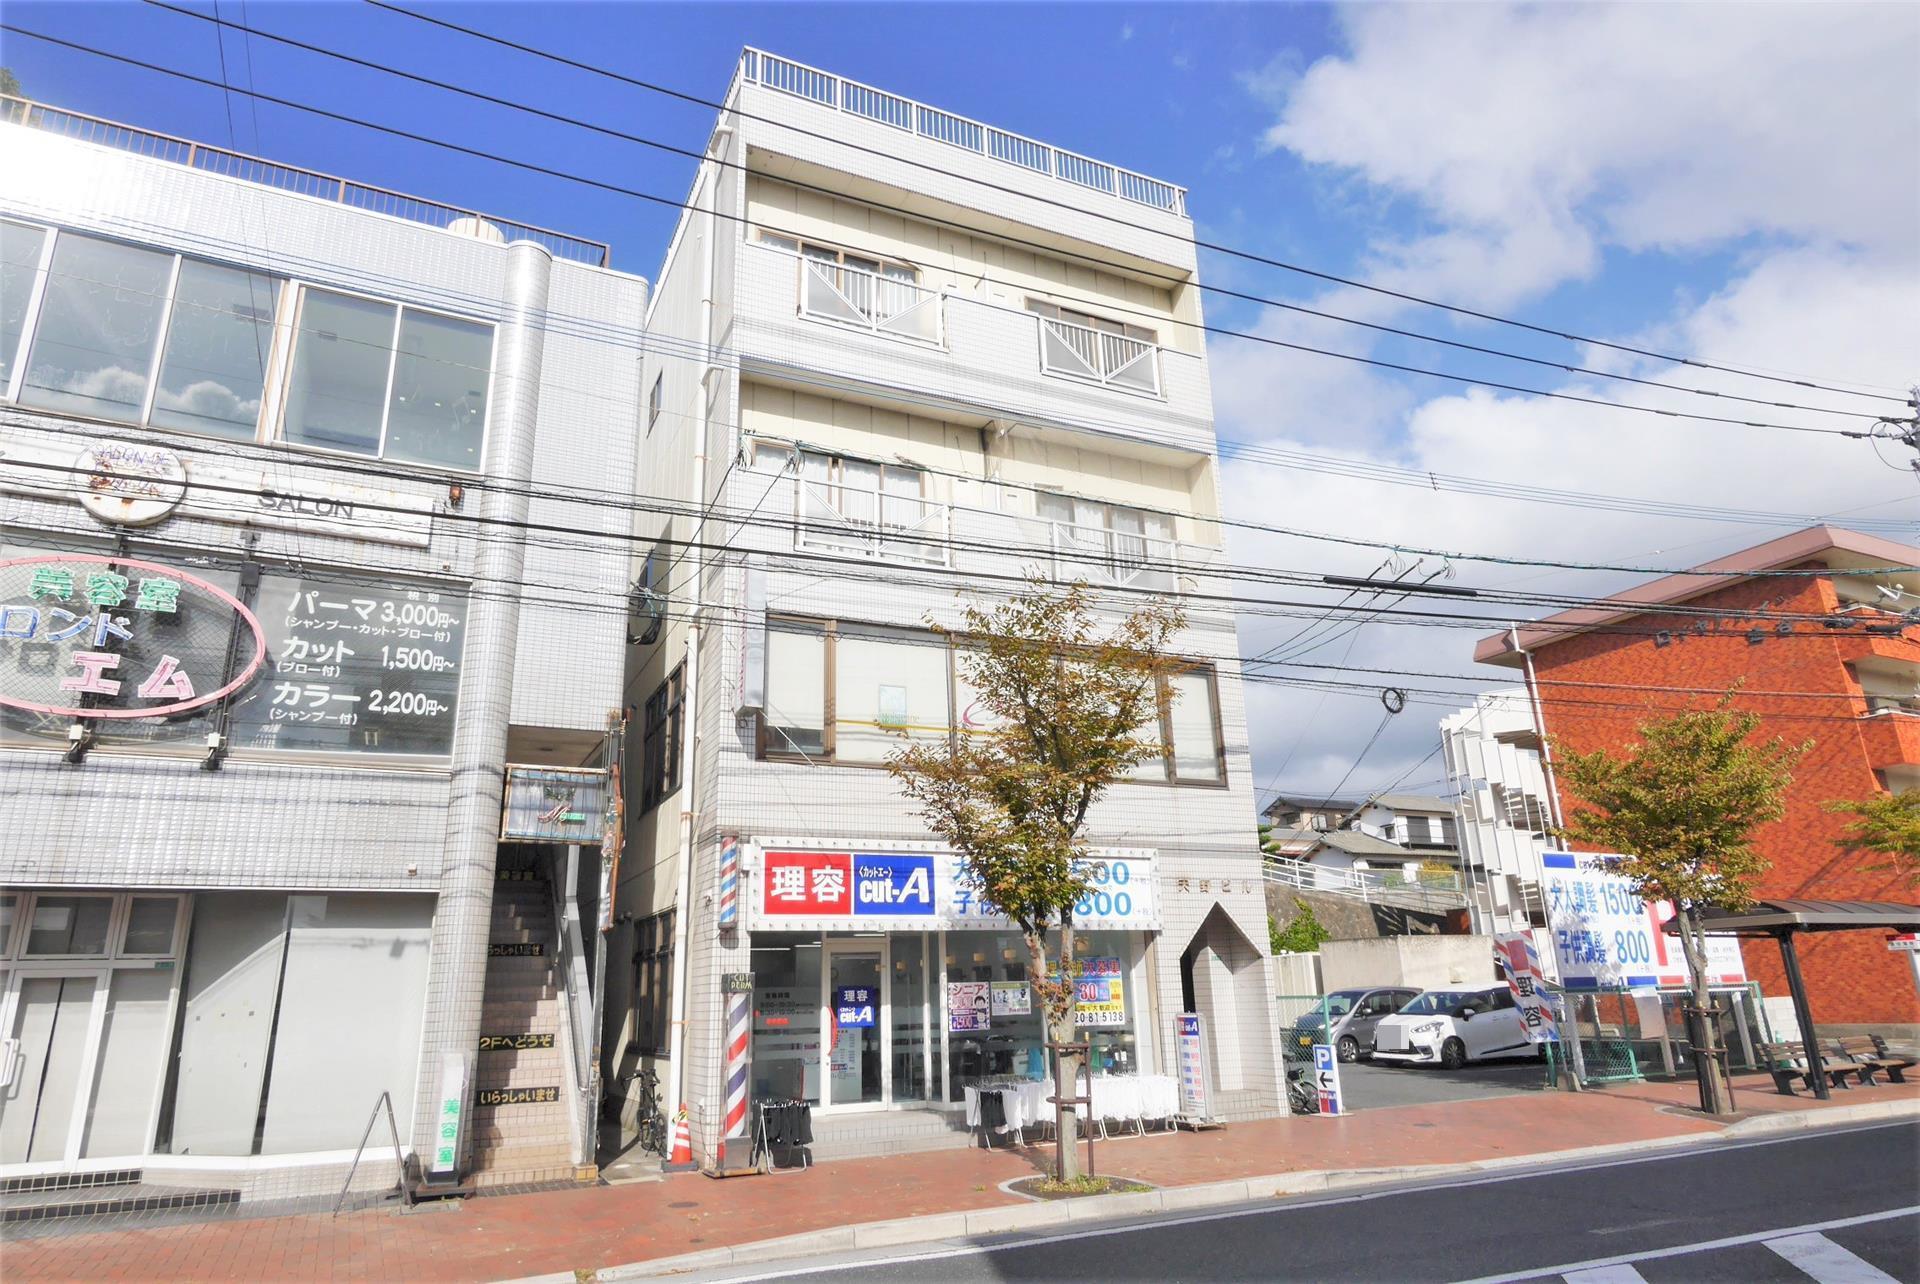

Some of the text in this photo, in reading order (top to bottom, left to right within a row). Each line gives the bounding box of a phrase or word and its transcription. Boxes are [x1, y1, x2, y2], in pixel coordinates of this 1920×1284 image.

[258, 488, 354, 518] SALON
[27, 565, 182, 613] 美容室
[407, 591, 439, 603] 税別
[288, 590, 377, 620] パーマ
[0, 604, 134, 647] ロンド
[280, 636, 355, 663] カット
[59, 651, 196, 700] エム
[272, 681, 361, 707] カラー
[771, 864, 846, 903] 理容
[859, 867, 930, 903] cut-A
[1074, 892, 1132, 916] 800
[1615, 929, 1650, 964] 800
[844, 990, 868, 1001] 理容
[952, 984, 985, 995] シニア
[1079, 983, 1097, 1001] 30
[480, 1034, 553, 1050] 2Fへどうぞ
[1316, 1048, 1330, 1069] P
[480, 1087, 556, 1104] いらっしゃいませ
[437, 1098, 460, 1163] 美容室
